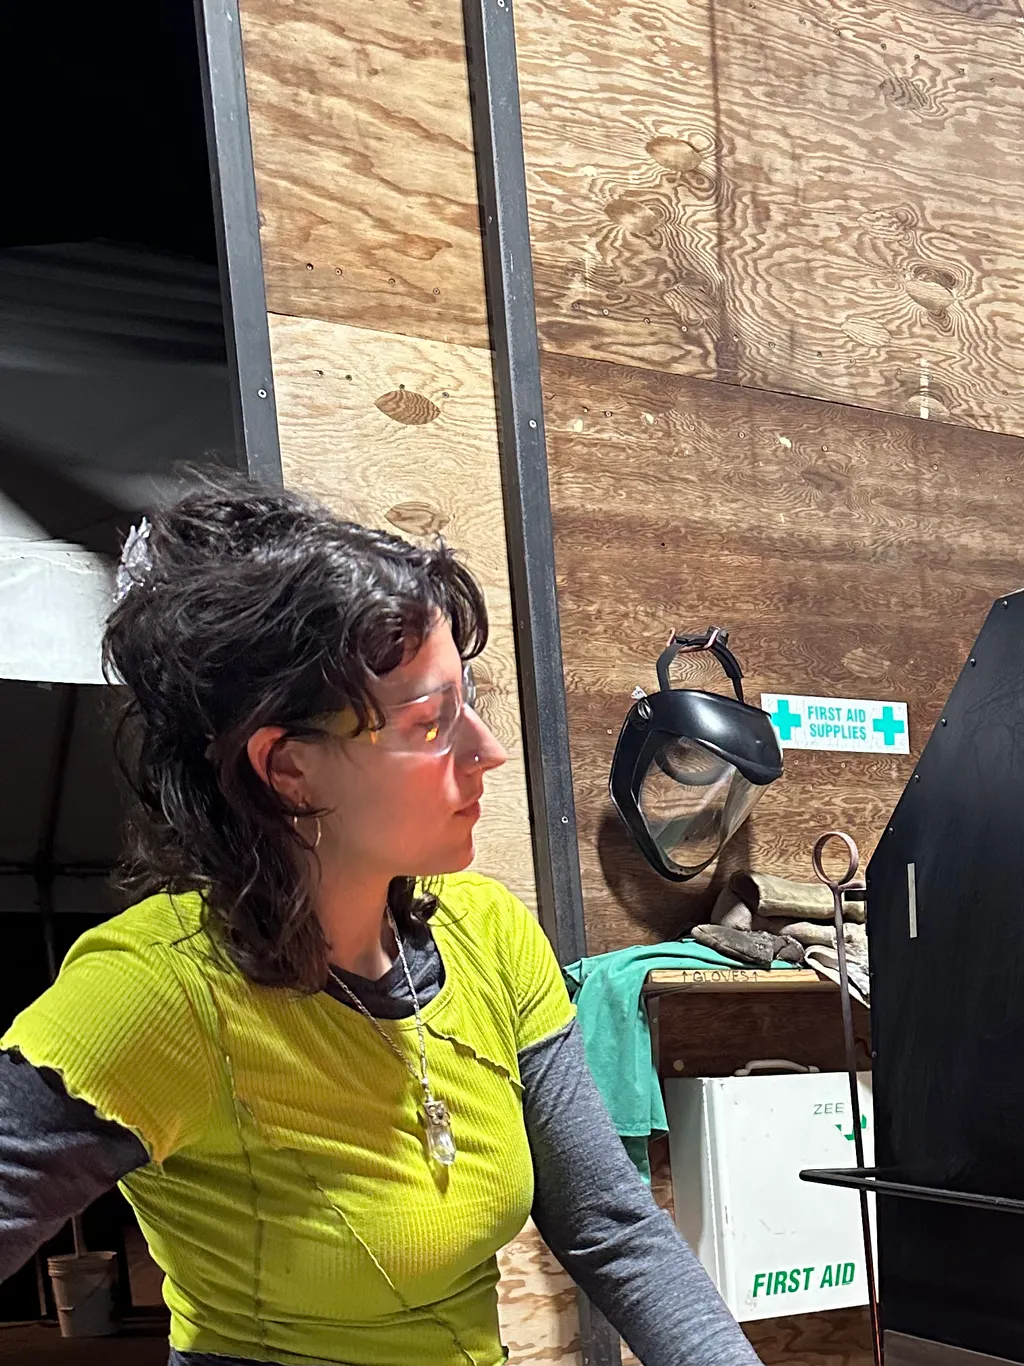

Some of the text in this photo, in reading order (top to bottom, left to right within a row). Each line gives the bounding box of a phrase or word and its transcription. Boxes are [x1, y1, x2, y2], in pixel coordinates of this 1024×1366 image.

[807, 705, 867, 723] FIRST AID
[809, 723, 867, 740] SUPPLIES
[692, 970, 750, 982] GLOVES
[813, 1102, 845, 1115] ZEE
[752, 1262, 855, 1298] FIRST AID
